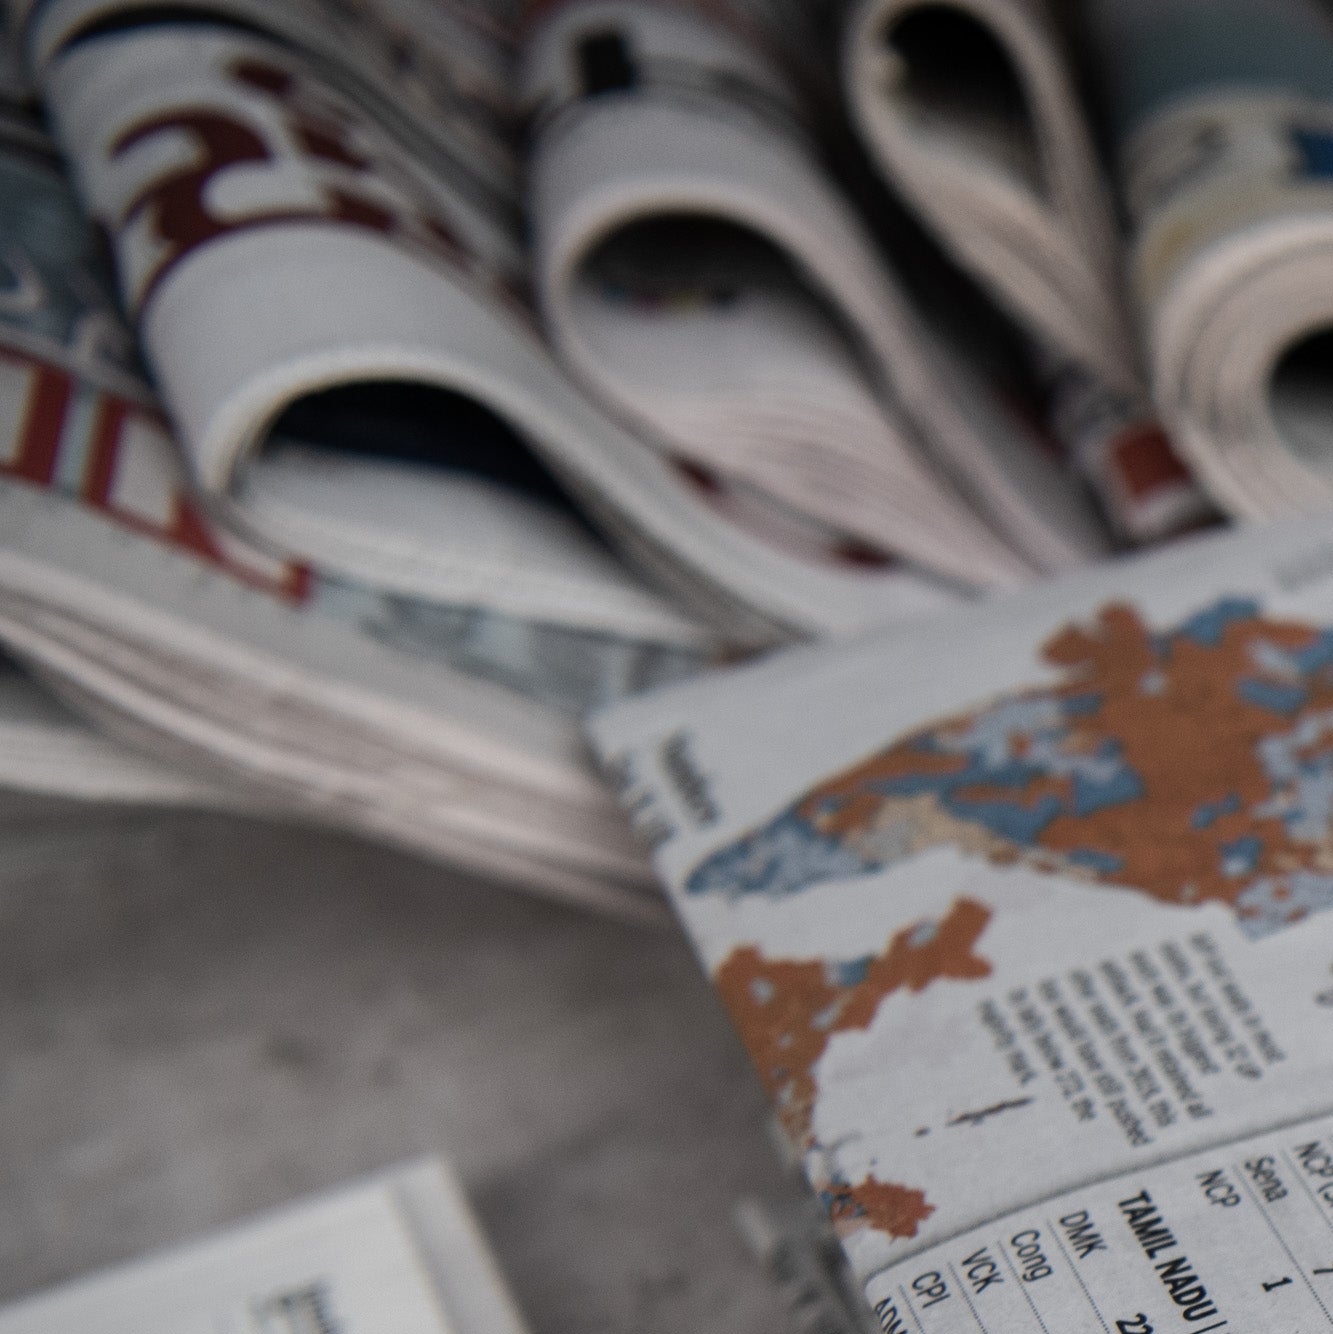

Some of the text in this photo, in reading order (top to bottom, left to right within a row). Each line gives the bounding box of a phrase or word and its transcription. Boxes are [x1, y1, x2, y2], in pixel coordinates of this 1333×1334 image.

[1009, 1229, 1052, 1283] Cong
[1057, 1210, 1106, 1260] DMK
[1117, 1190, 1176, 1260] TAMIL
[1153, 1256, 1217, 1322] NADU
